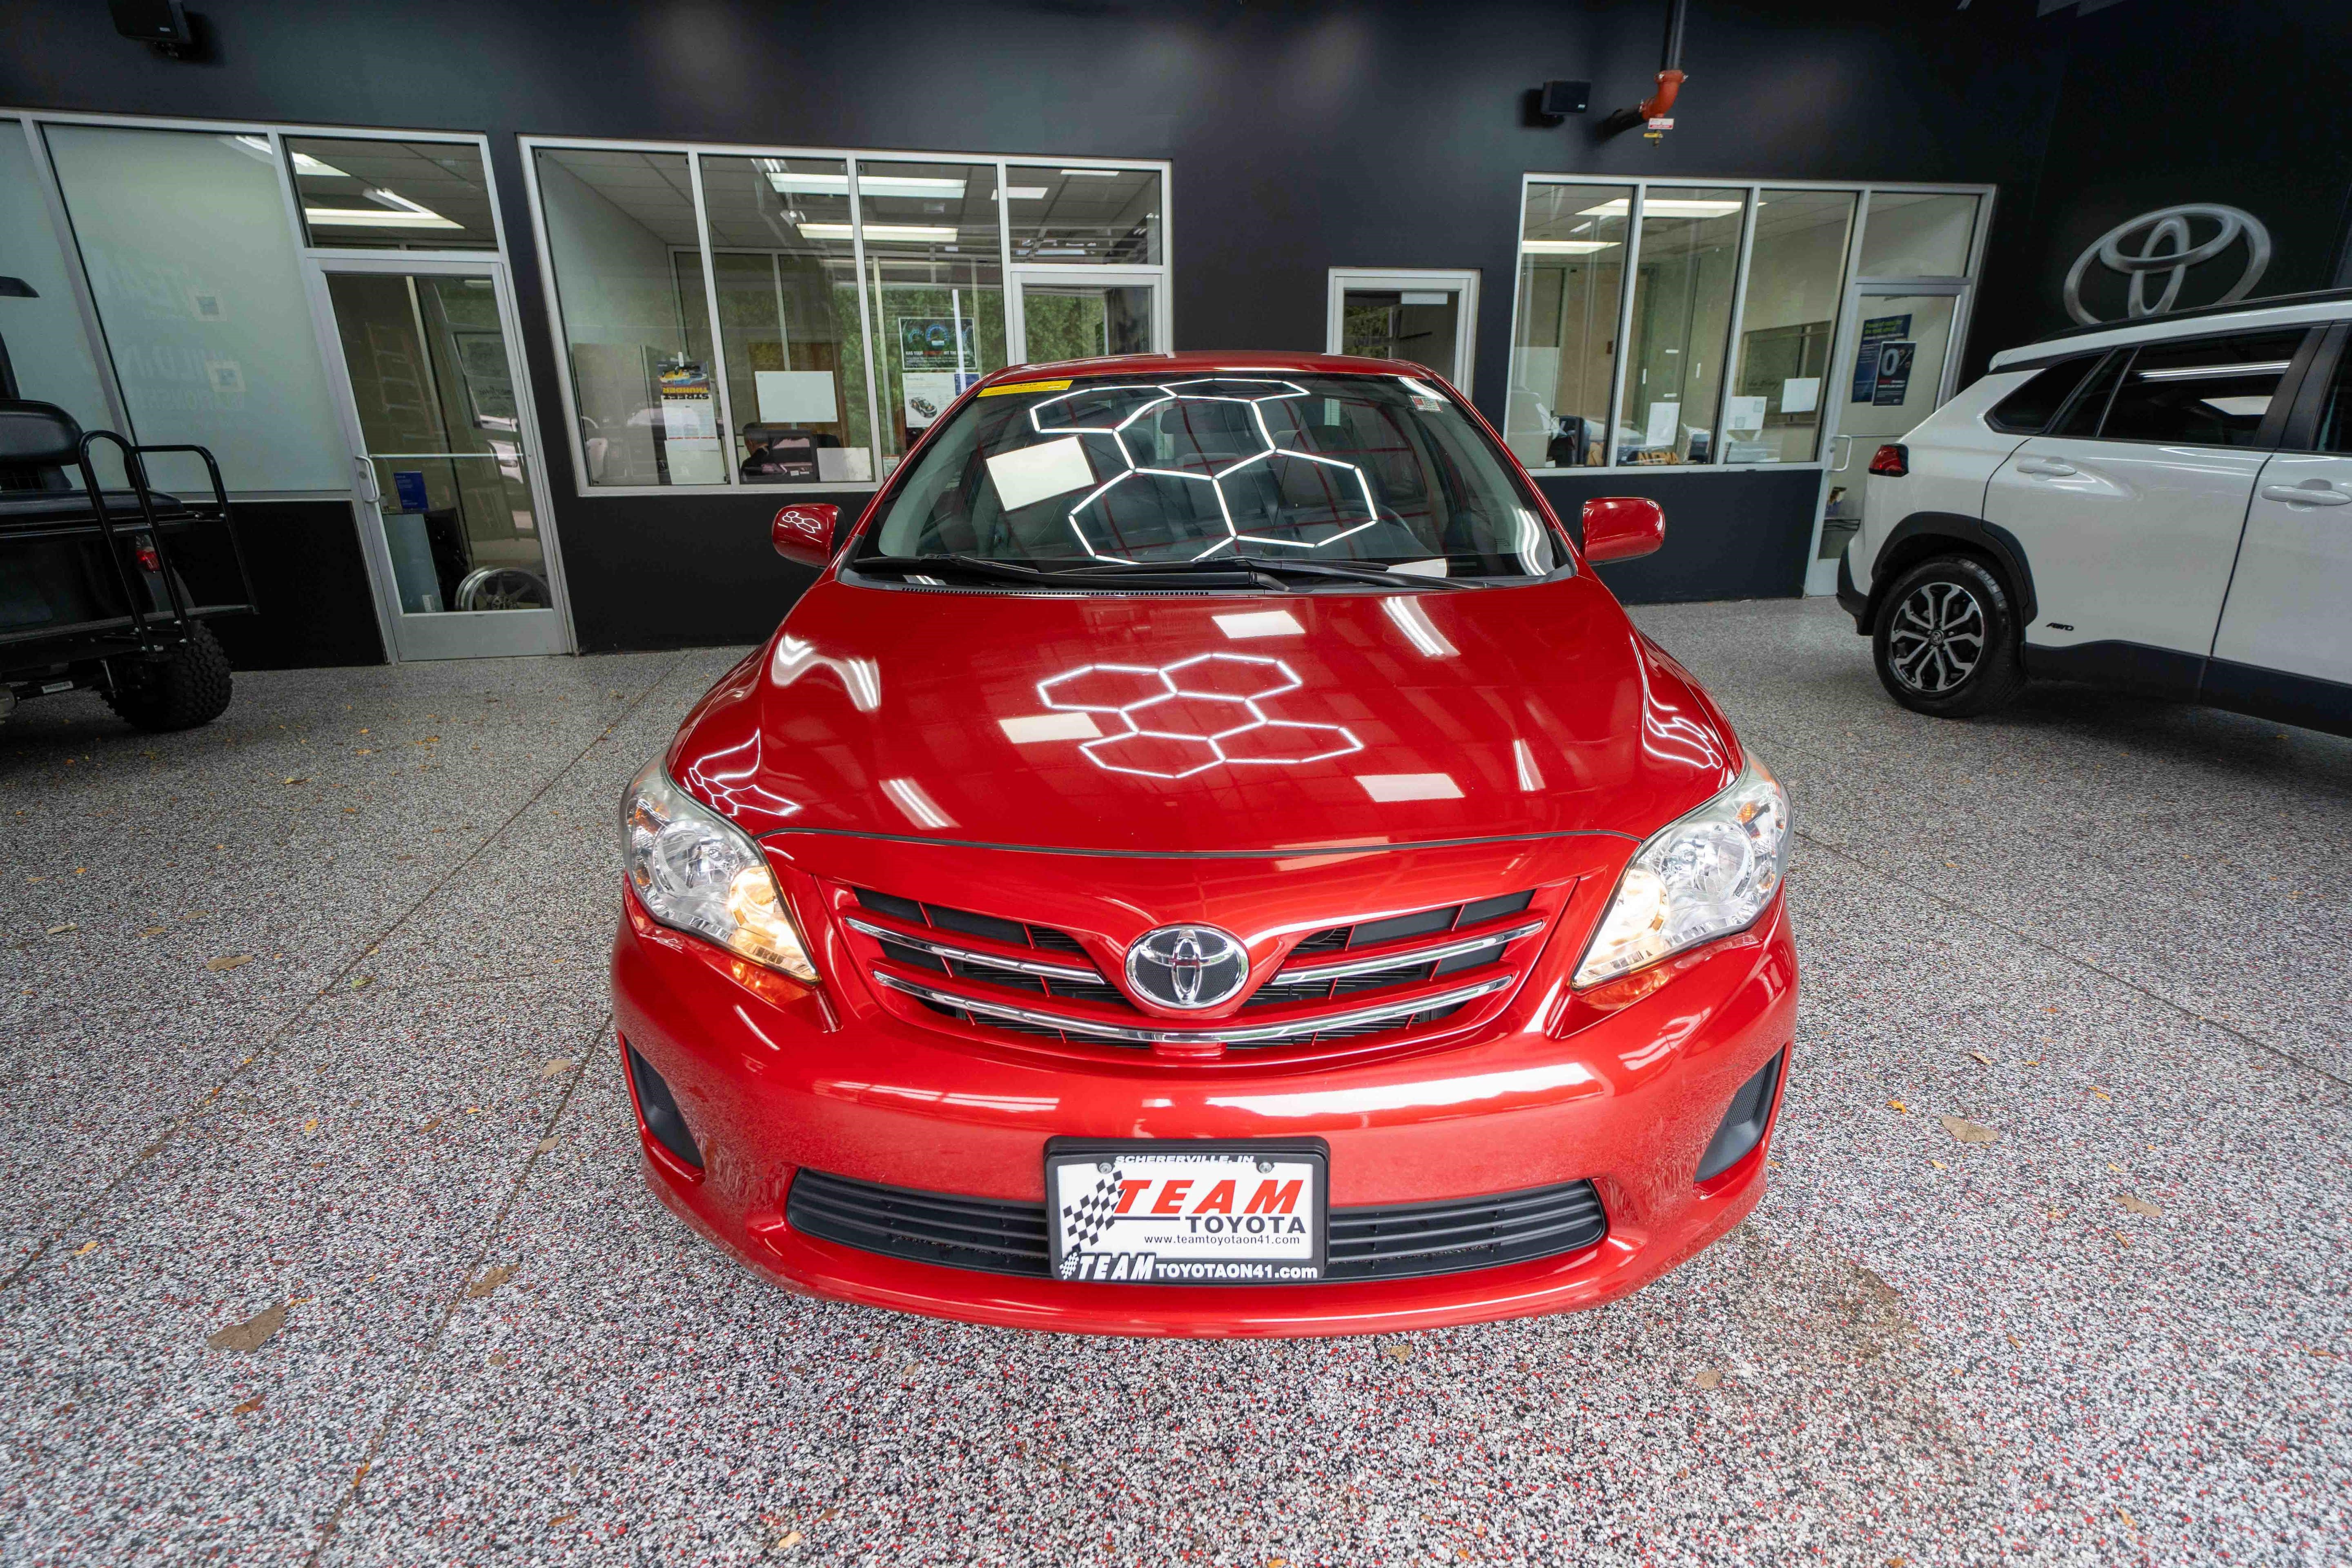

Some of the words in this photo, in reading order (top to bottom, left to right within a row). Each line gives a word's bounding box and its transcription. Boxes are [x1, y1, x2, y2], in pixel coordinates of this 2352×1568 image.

[1237, 1156, 1254, 1164] IN
[1114, 1179, 1304, 1214] TEAM
[1185, 1216, 1306, 1234] TOYOTA
[1144, 1234, 1300, 1246] www.teamtoyotaon41.com
